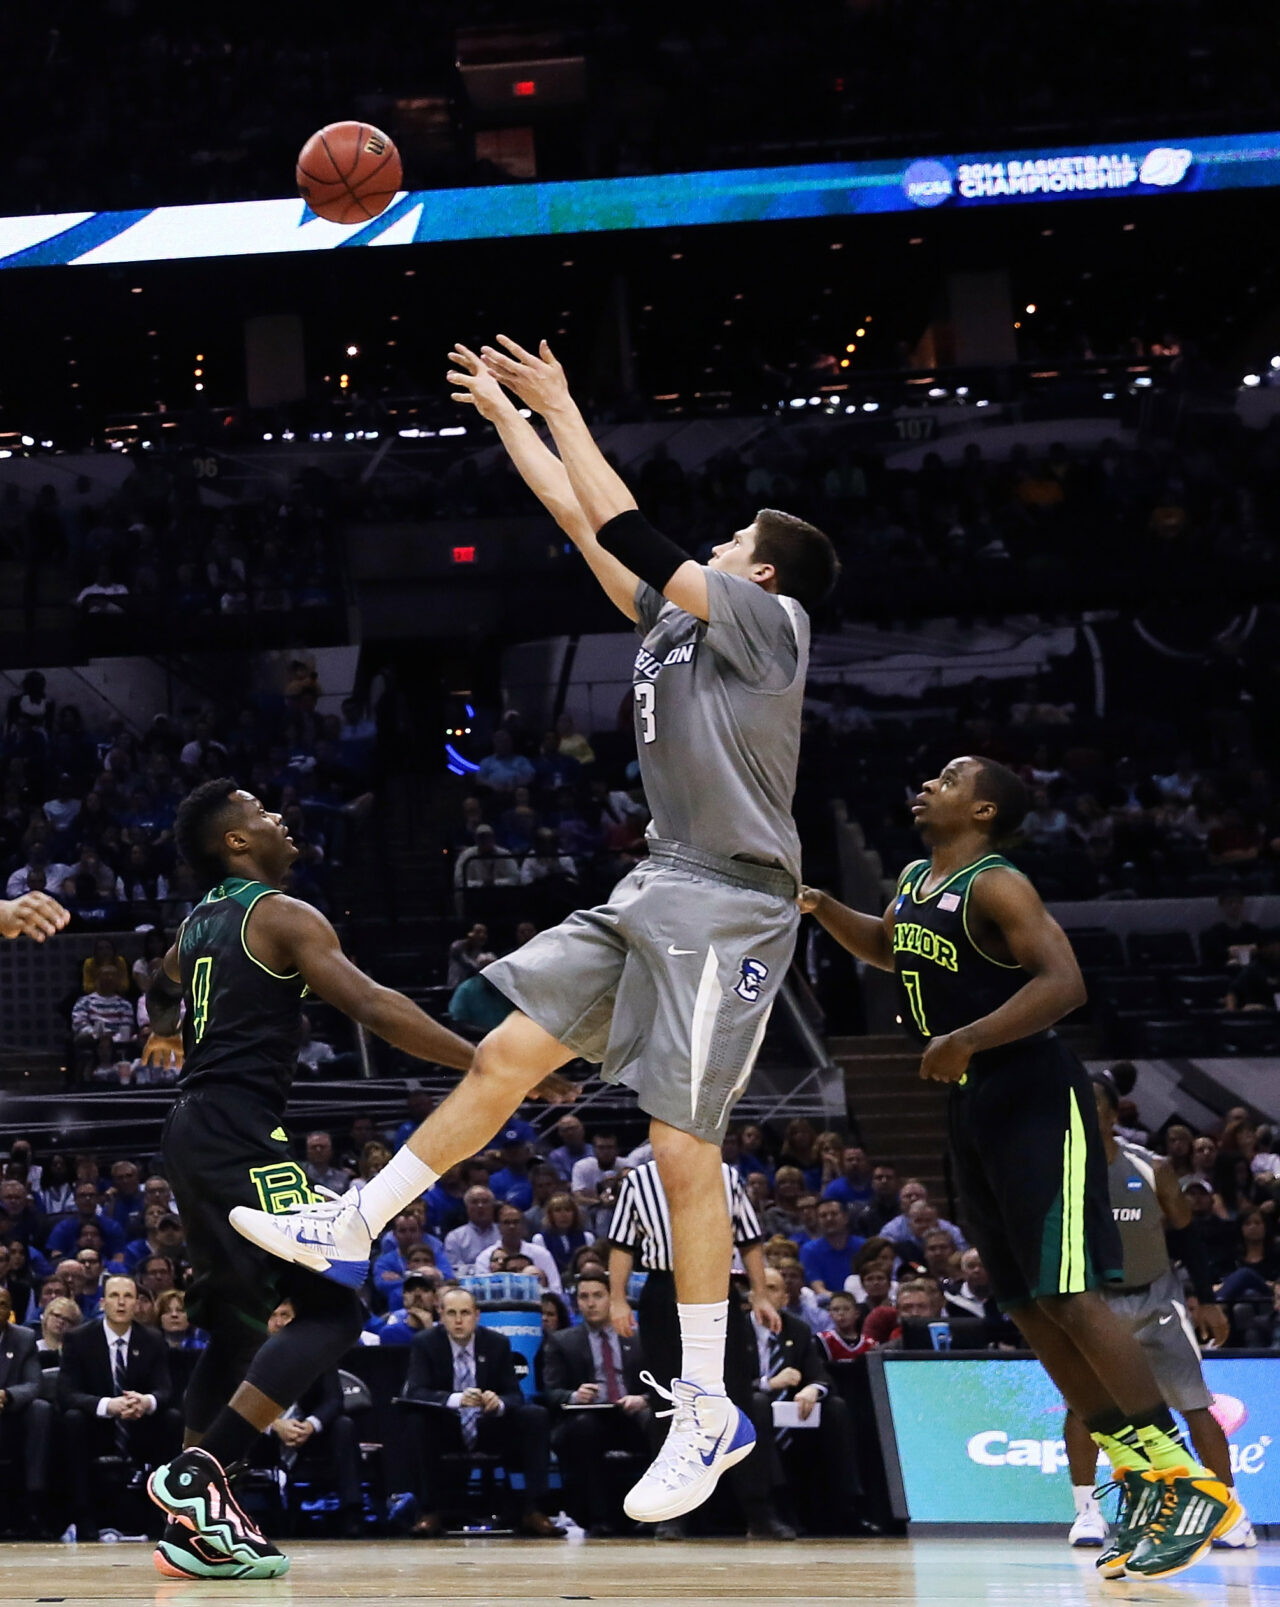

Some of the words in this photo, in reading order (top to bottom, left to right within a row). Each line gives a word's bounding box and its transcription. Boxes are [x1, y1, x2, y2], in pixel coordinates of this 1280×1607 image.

[958, 163, 1006, 182] 2014
[1007, 154, 1136, 176] BASKETBALL
[959, 168, 1138, 198] CHAMPIONSHIP
[633, 682, 656, 744] 3
